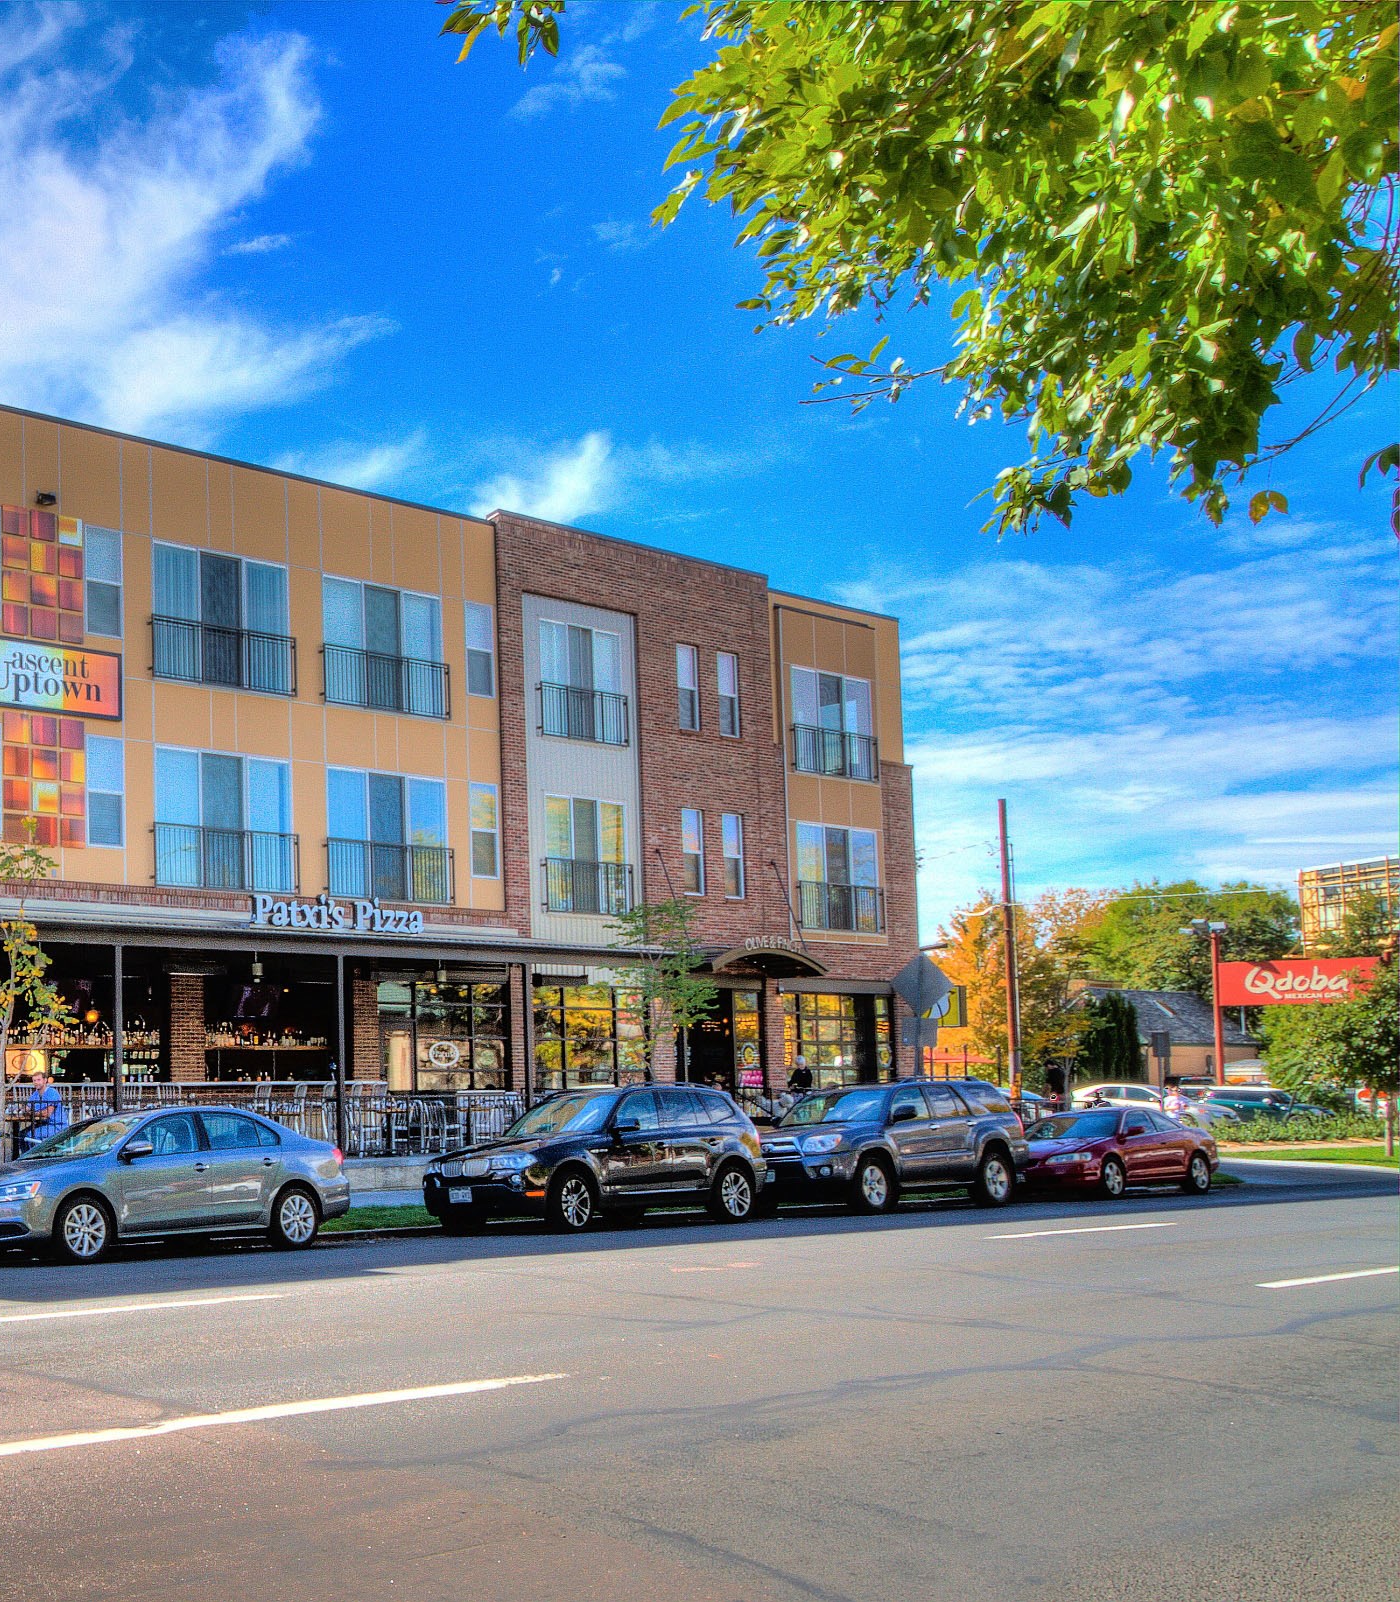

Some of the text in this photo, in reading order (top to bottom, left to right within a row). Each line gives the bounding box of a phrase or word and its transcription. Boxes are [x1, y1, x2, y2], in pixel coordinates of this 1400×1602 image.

[11, 652, 89, 679] ascent
[252, 893, 425, 934] Patxi's Pizza
[1244, 965, 1349, 999] Qdoba
